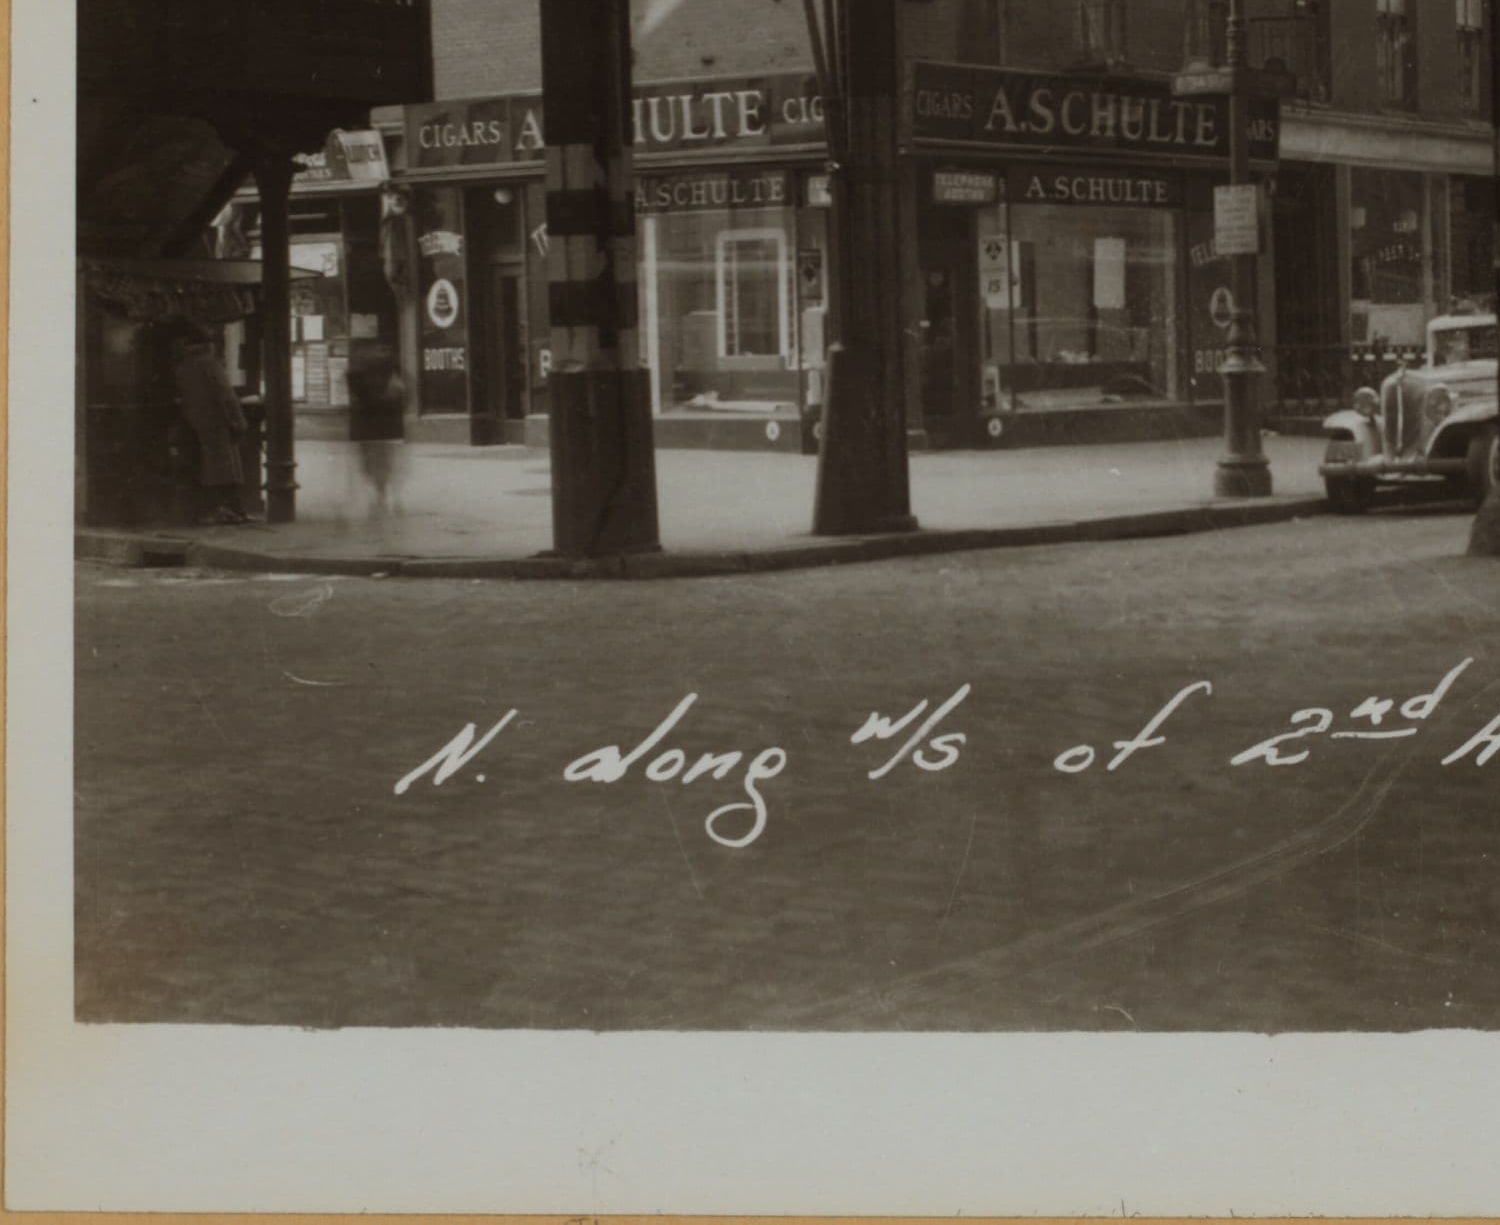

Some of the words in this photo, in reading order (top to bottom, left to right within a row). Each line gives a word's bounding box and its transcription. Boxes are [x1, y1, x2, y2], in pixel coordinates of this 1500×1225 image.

[419, 121, 501, 149] CIGARS
[782, 95, 825, 124] CIG
[916, 89, 973, 119] CIGARS
